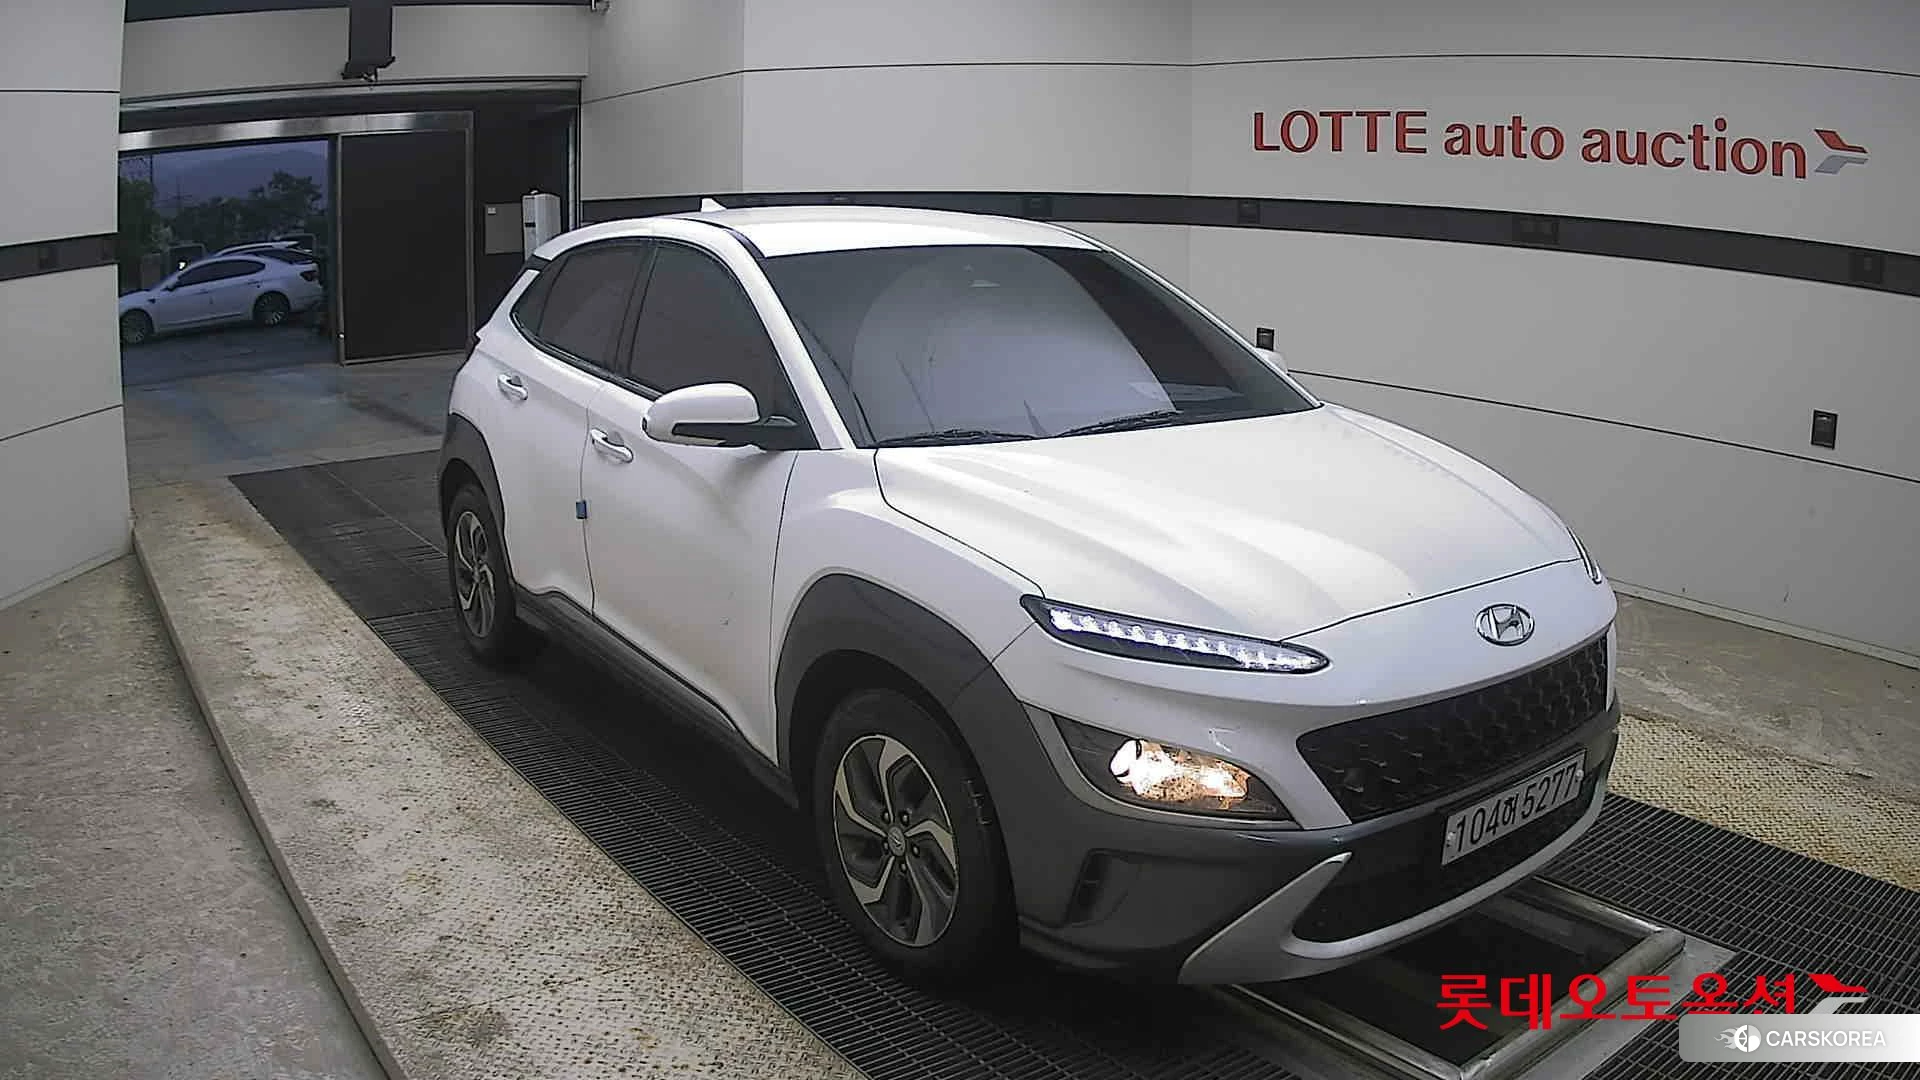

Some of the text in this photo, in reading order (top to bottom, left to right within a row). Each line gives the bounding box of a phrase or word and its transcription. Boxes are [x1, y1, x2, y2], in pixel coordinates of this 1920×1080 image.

[1253, 111, 1808, 177] LOTTE auto auction
